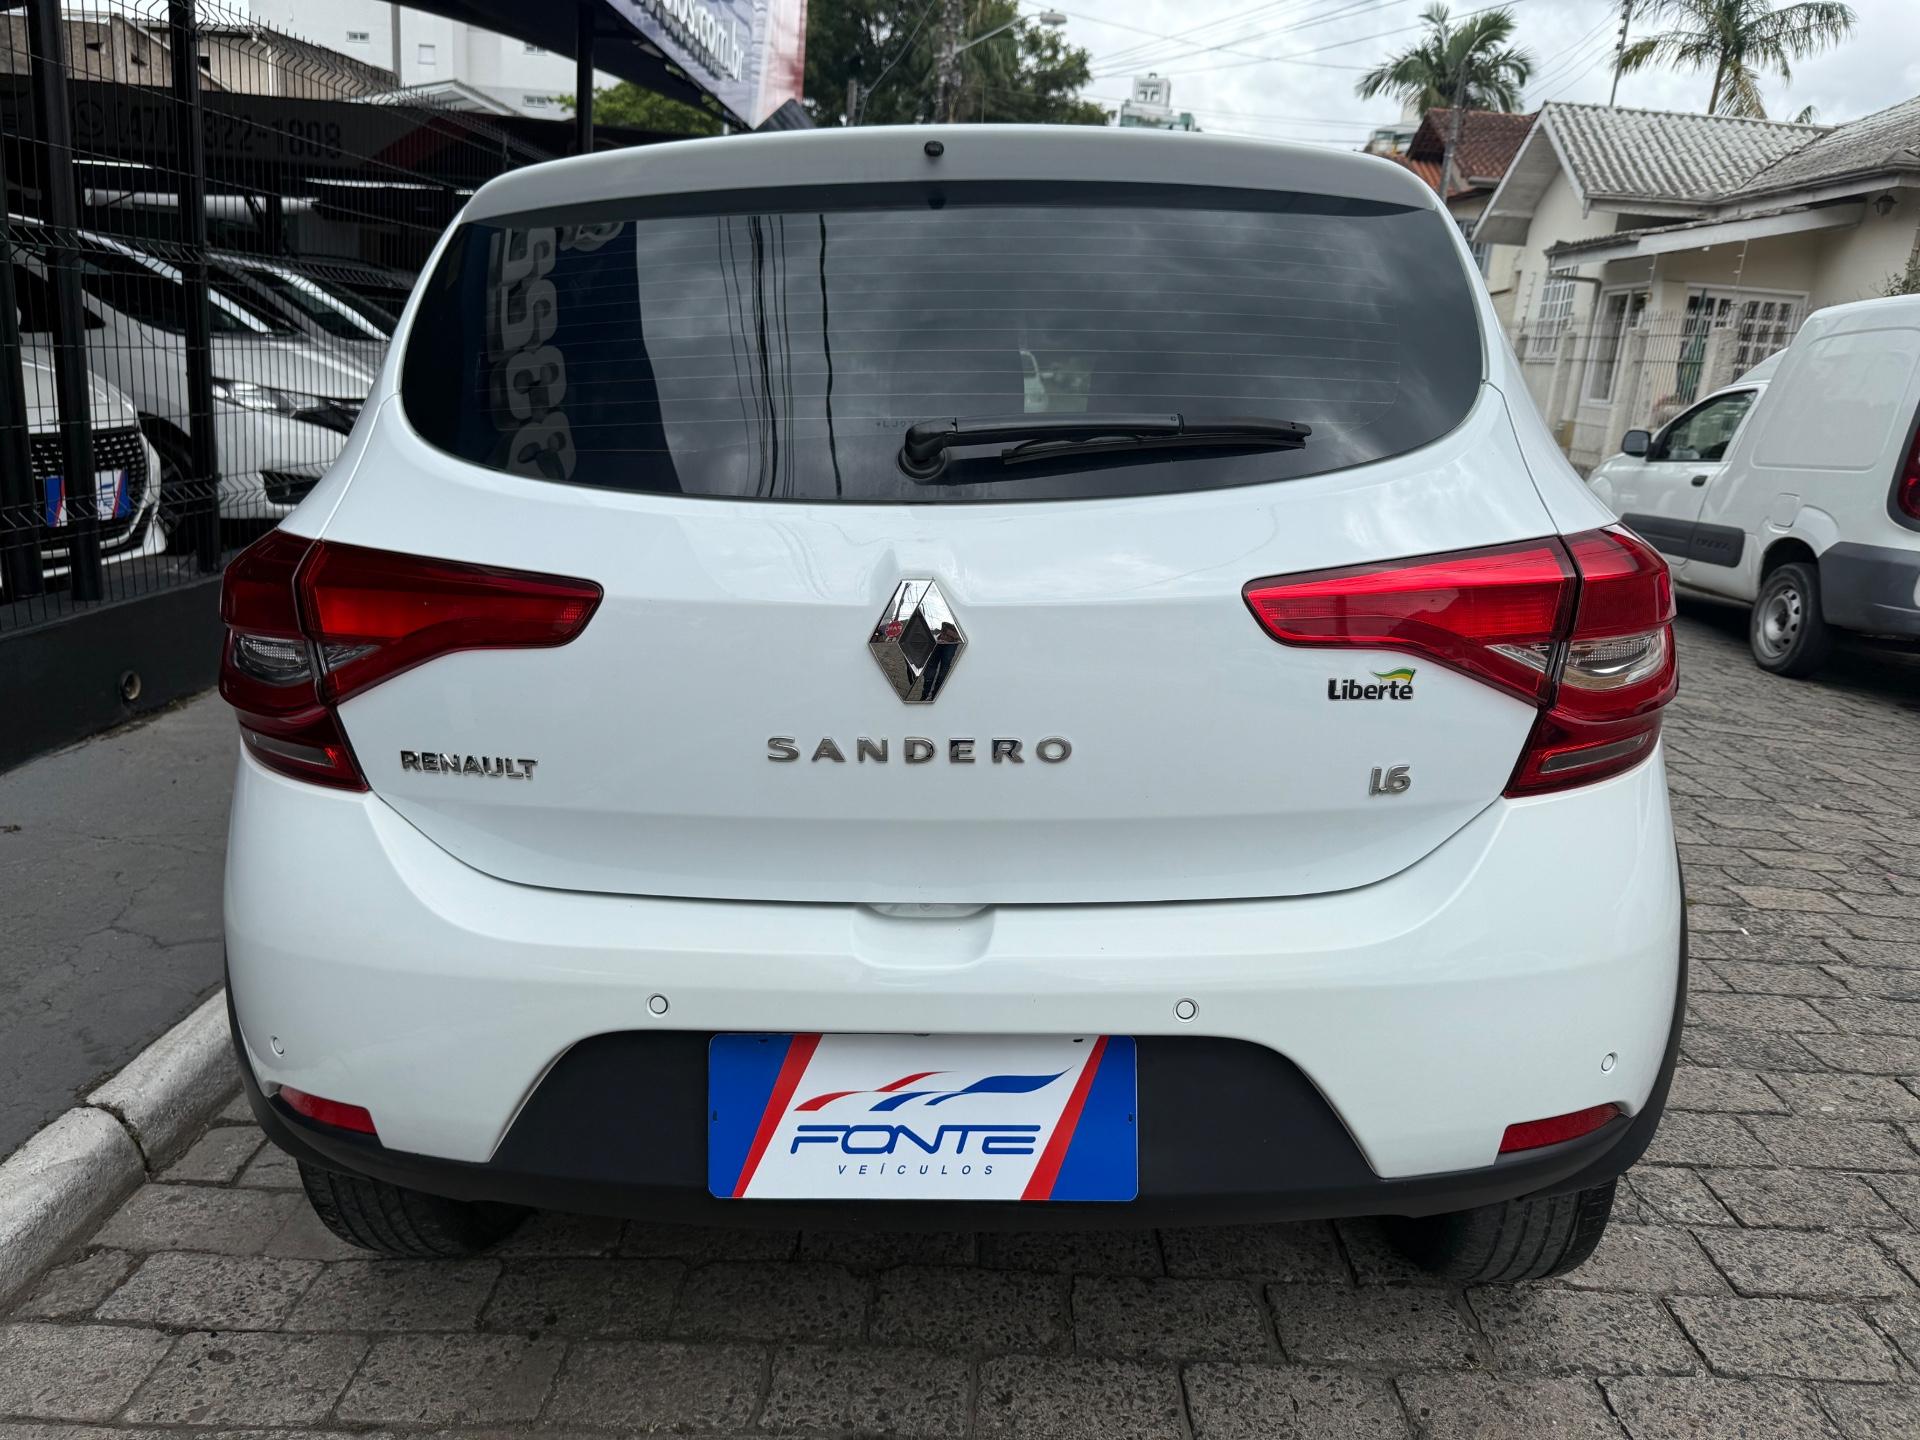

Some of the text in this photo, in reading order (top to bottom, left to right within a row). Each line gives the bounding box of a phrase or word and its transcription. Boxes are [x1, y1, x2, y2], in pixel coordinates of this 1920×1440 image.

[767, 736, 1073, 763] SANDERO
[400, 750, 538, 780] RENAULT
[1368, 764, 1412, 796] 1.6
[790, 1124, 1042, 1155] FONTE
[838, 1163, 995, 1176] VEÍCULOS
